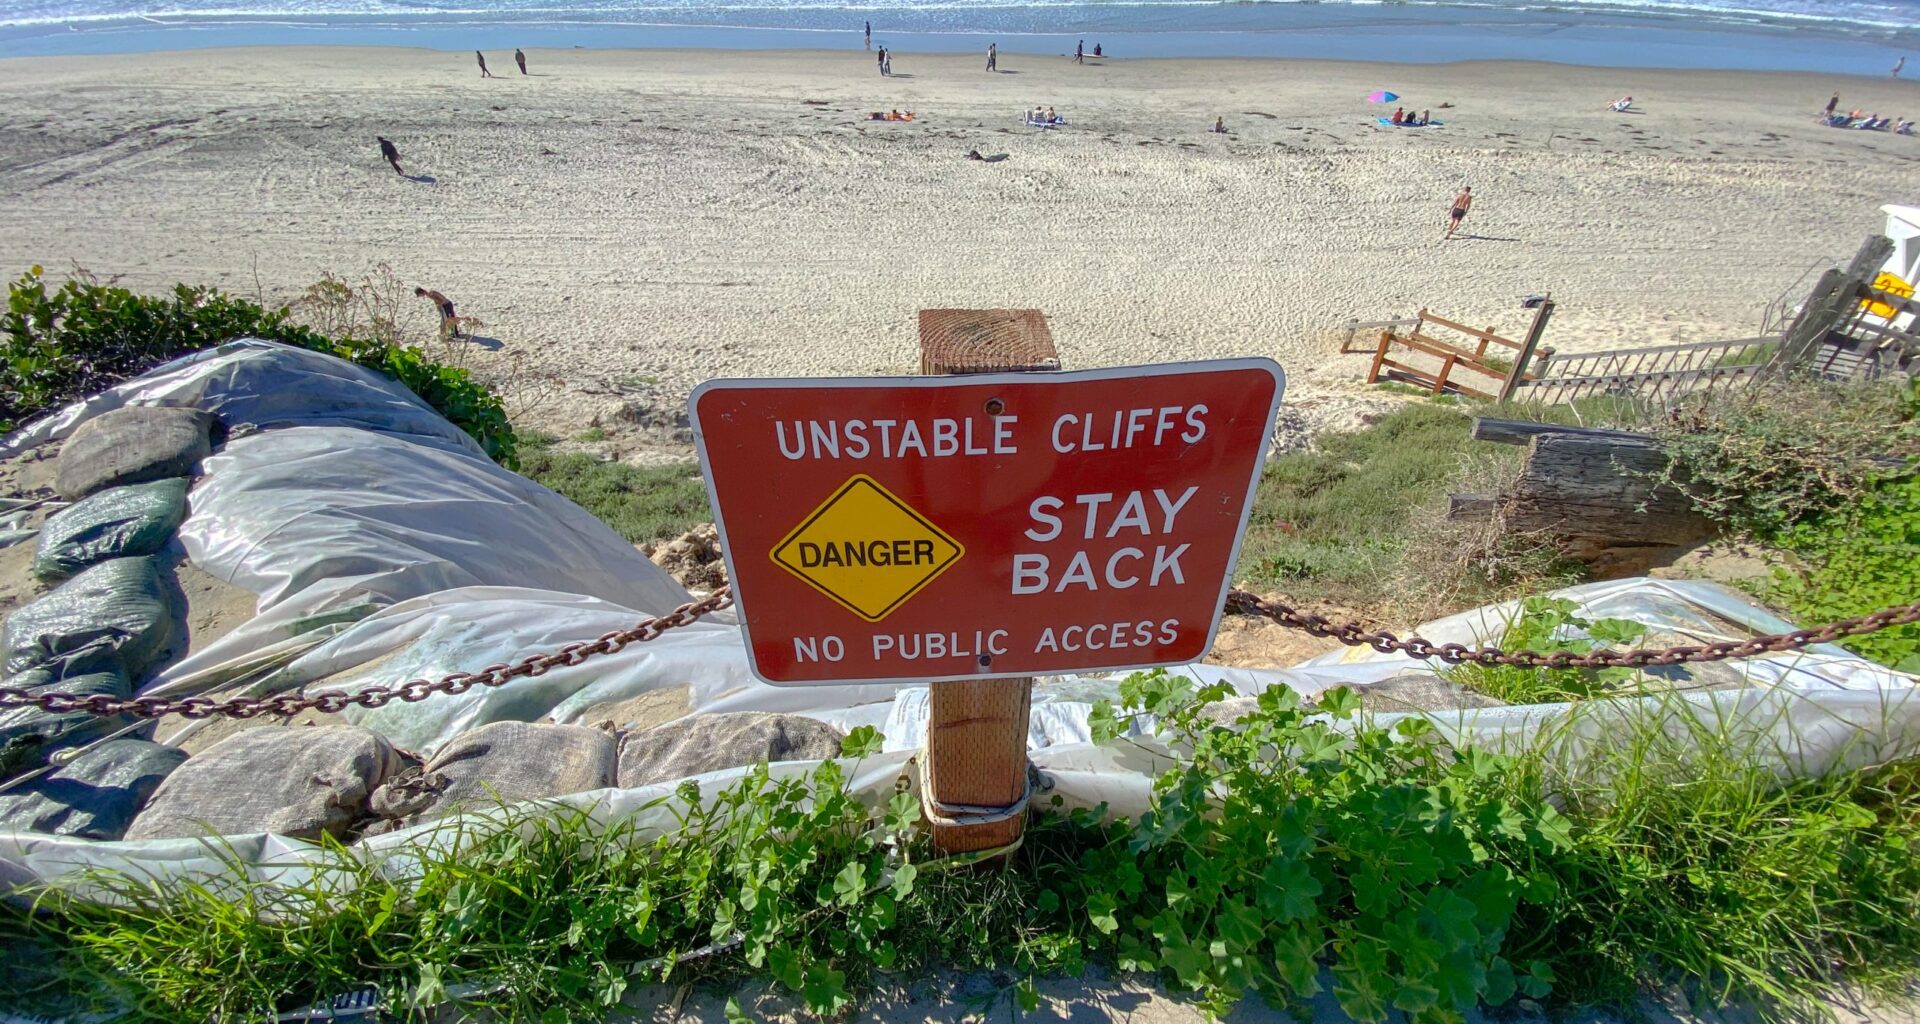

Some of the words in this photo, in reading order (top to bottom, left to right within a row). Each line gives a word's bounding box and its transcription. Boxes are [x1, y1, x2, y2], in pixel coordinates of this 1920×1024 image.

[775, 415, 1018, 460] UNSTABLE
[1052, 404, 1209, 453] CLIFFS
[1024, 486, 1199, 542] STAY
[798, 539, 935, 568] DANGER
[1011, 543, 1191, 595] BACK
[793, 635, 845, 663] NO
[872, 629, 1009, 660] PUBLIC
[1034, 618, 1180, 653] ACCESS
